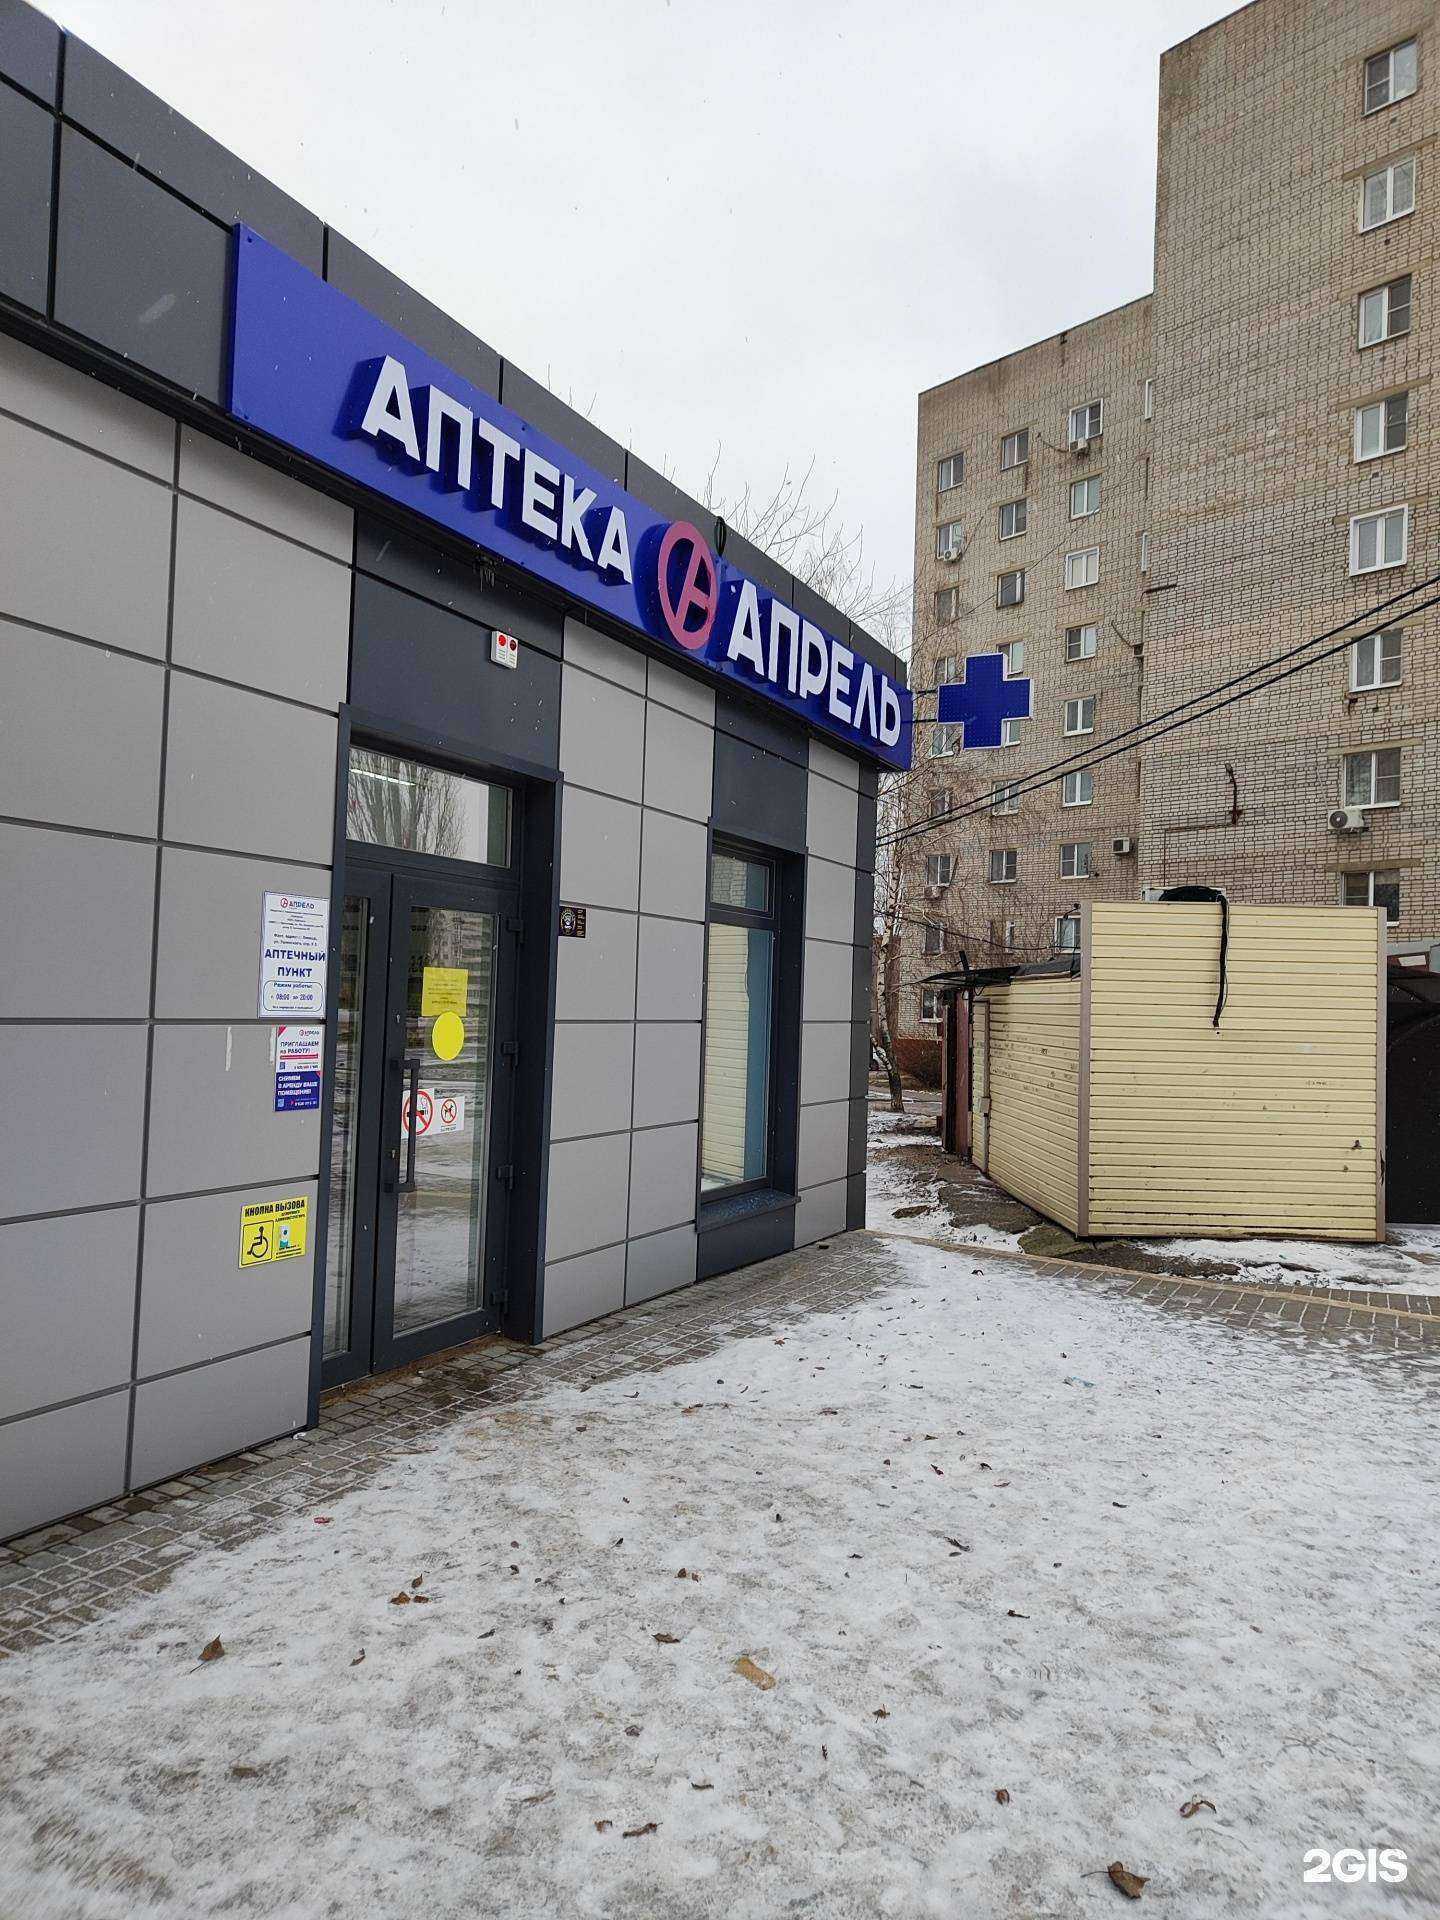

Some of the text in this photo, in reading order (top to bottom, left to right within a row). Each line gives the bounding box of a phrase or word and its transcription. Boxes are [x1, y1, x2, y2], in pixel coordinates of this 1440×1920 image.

[361, 354, 902, 748] АПТЕКА АПРЕЛЬ
[264, 948, 326, 961] АПТЕЧНЫЙ
[277, 966, 313, 977] ПУНКТ
[244, 1204, 274, 1218] КНОПКА
[275, 1199, 305, 1213] ВЫЗОВА
